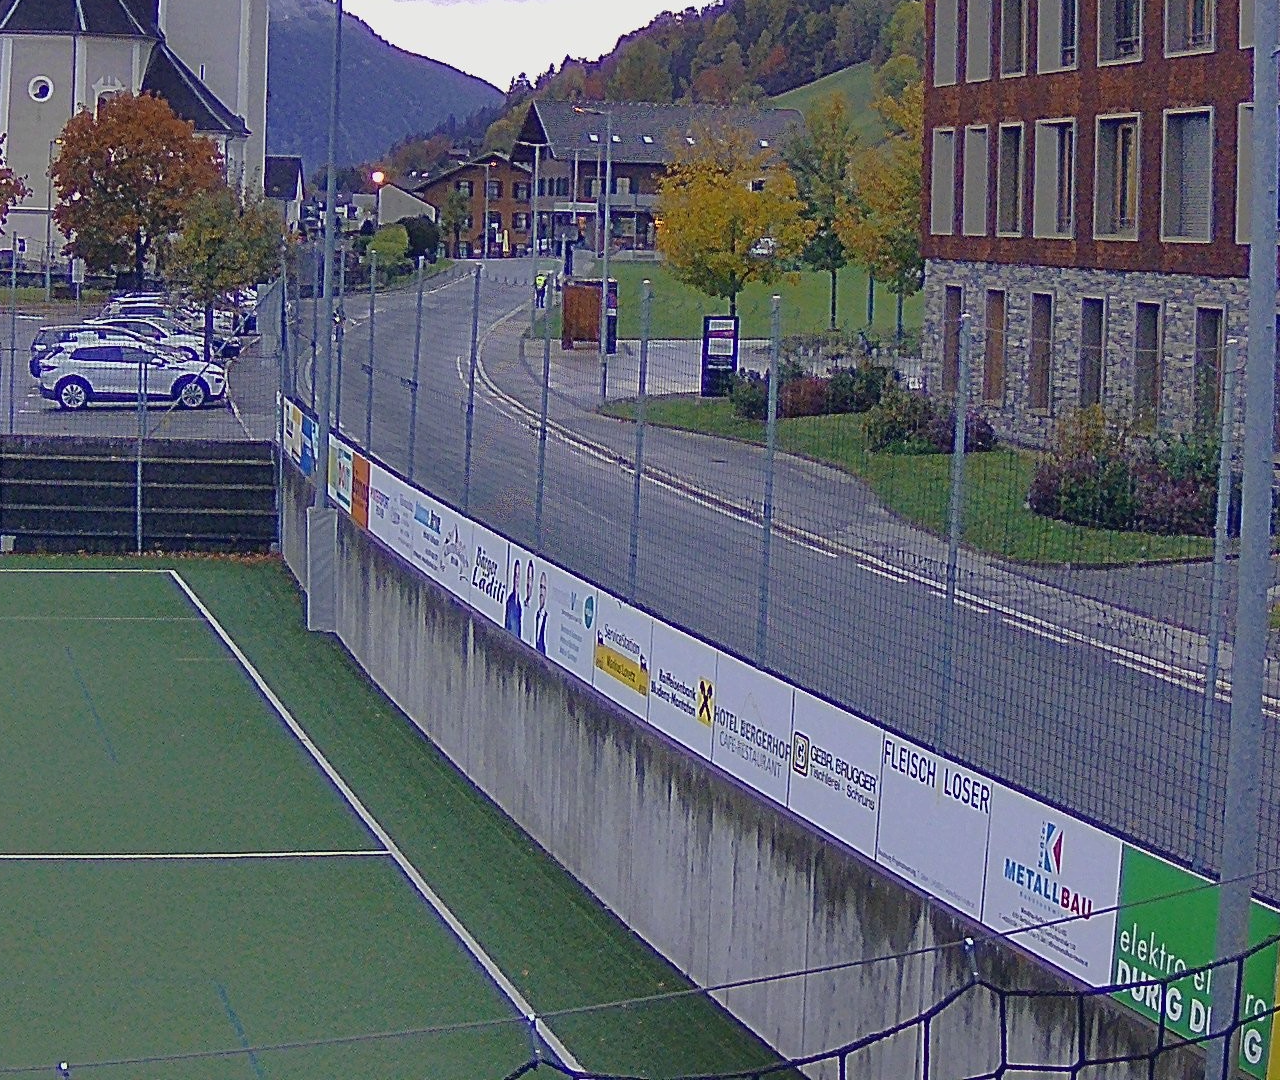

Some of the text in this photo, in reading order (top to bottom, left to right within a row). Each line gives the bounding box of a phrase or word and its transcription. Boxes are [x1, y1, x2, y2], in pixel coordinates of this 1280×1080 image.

[714, 705, 792, 762] HOTEL BERGERHOF
[810, 745, 834, 771] GEBR.
[883, 740, 990, 814] FLEISCH LOSER
[1004, 858, 1093, 921] METALLBAU
[1120, 922, 1187, 981] elektro
